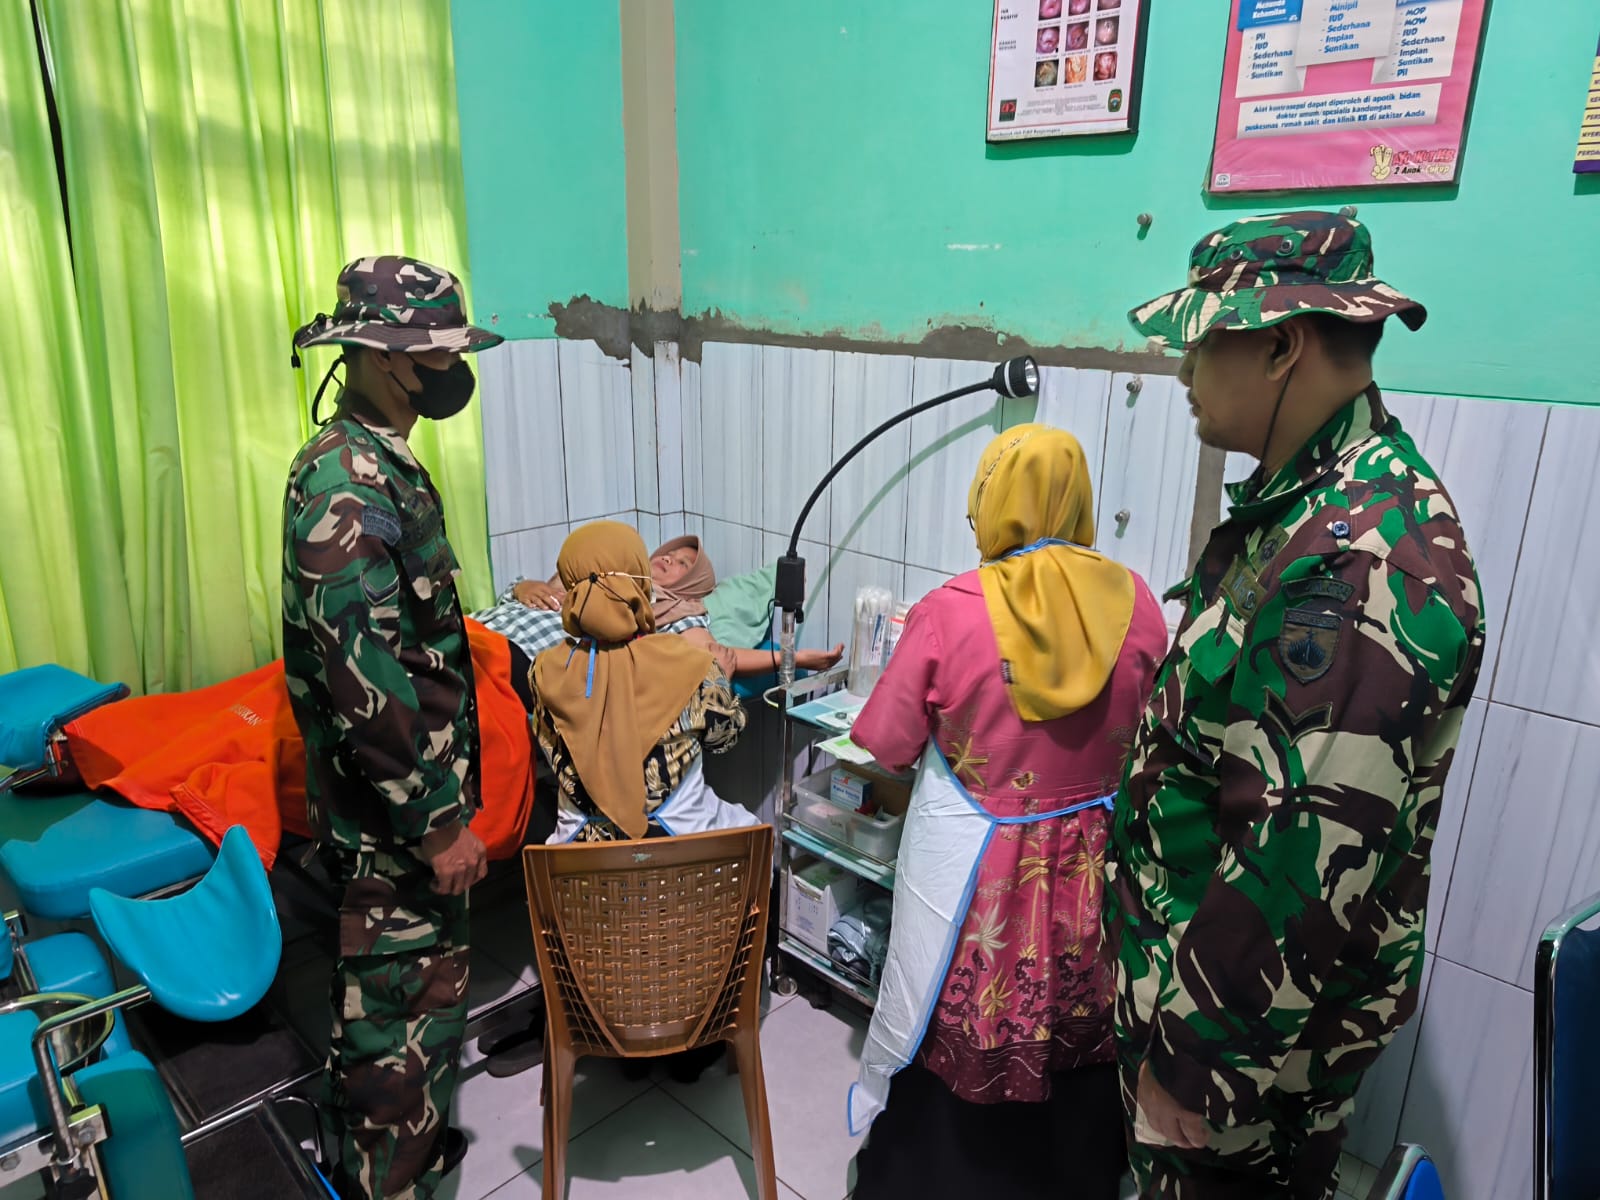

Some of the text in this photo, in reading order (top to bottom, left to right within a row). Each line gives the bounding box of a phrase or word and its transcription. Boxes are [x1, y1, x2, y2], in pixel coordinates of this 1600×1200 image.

[1405, 6, 1426, 16] MOP
[1328, 13, 1344, 23] IUD
[1403, 16, 1427, 26] MOW
[1327, 21, 1371, 33] Sederhana
[1402, 27, 1418, 37] IUD
[1325, 33, 1354, 43] Implan
[1400, 35, 1446, 47] Sederhana
[1254, 41, 1269, 51] IUD
[1324, 42, 1360, 54] Suntikan
[1253, 49, 1293, 61] Sederhana
[1399, 47, 1428, 57] Implan
[1252, 60, 1278, 70] Implan
[1397, 57, 1434, 67] Suntikan
[1250, 70, 1283, 80] Suntikan
[1396, 67, 1409, 77] Pil
[1307, 100, 1328, 109] dapat
[1328, 97, 1362, 107] diperoleh
[1363, 95, 1371, 103] di
[1399, 92, 1421, 100] bidan
[1276, 111, 1297, 120] dokter
[1322, 106, 1351, 117] spesialis
[1352, 104, 1392, 113] kandungan
[1322, 117, 1336, 125] dan
[1337, 115, 1356, 123] klinik
[1358, 113, 1368, 121] KB
[1378, 111, 1402, 120] sekitar
[1404, 109, 1426, 118] Anda
[1394, 167, 1401, 175] 2
[1401, 165, 1422, 174] Anak
